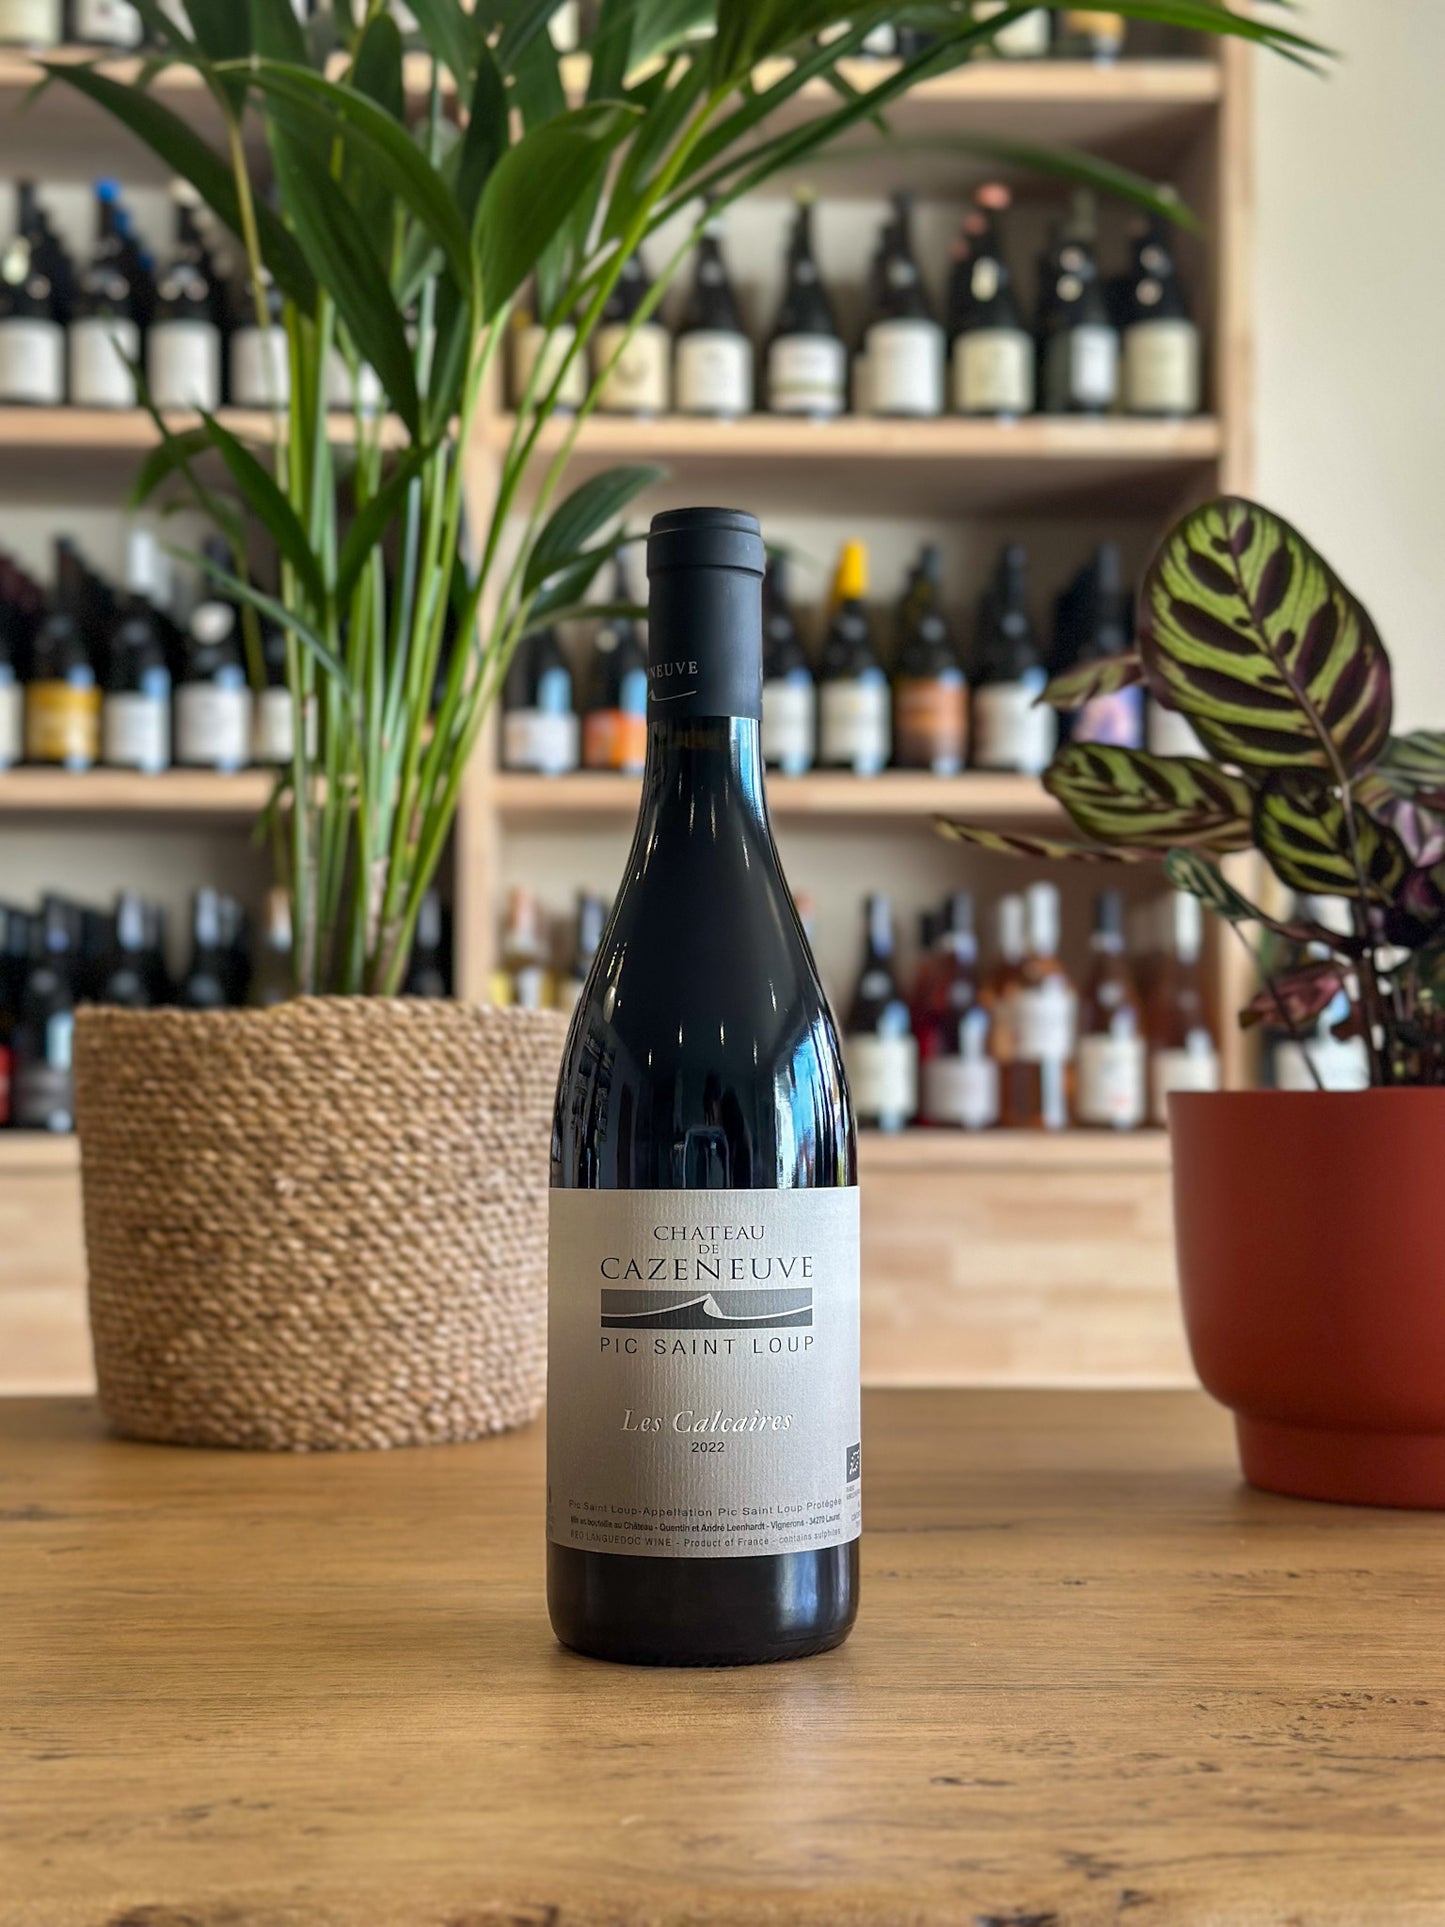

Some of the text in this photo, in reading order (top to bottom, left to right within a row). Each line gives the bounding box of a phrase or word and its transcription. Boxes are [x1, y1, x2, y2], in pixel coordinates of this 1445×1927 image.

[653, 1225, 765, 1241] CHATEAU
[699, 1244, 719, 1255] DE
[600, 1256, 813, 1281] CAZENEUVE
[600, 1336, 814, 1355] PIC SAINT LOUP
[620, 1407, 793, 1433] Les Calcaires
[691, 1441, 725, 1453] 2022
[583, 1501, 608, 1513] Saint
[718, 1507, 738, 1517] Pic
[742, 1505, 773, 1516] Saint
[777, 1504, 803, 1514] Loup
[806, 1498, 842, 1511] Protégée
[623, 1521, 654, 1532] Château
[659, 1523, 690, 1533] Quentin
[691, 1524, 700, 1533] et
[700, 1522, 725, 1533] André
[726, 1522, 766, 1532] Leenhardt
[770, 1519, 805, 1531] Vignerons
[586, 1531, 641, 1546] LANGUEDOC
[643, 1537, 672, 1547] WINE
[683, 1538, 721, 1548] Product
[724, 1538, 734, 1547] of
[737, 1537, 769, 1547] France
[779, 1533, 813, 1544] contains
